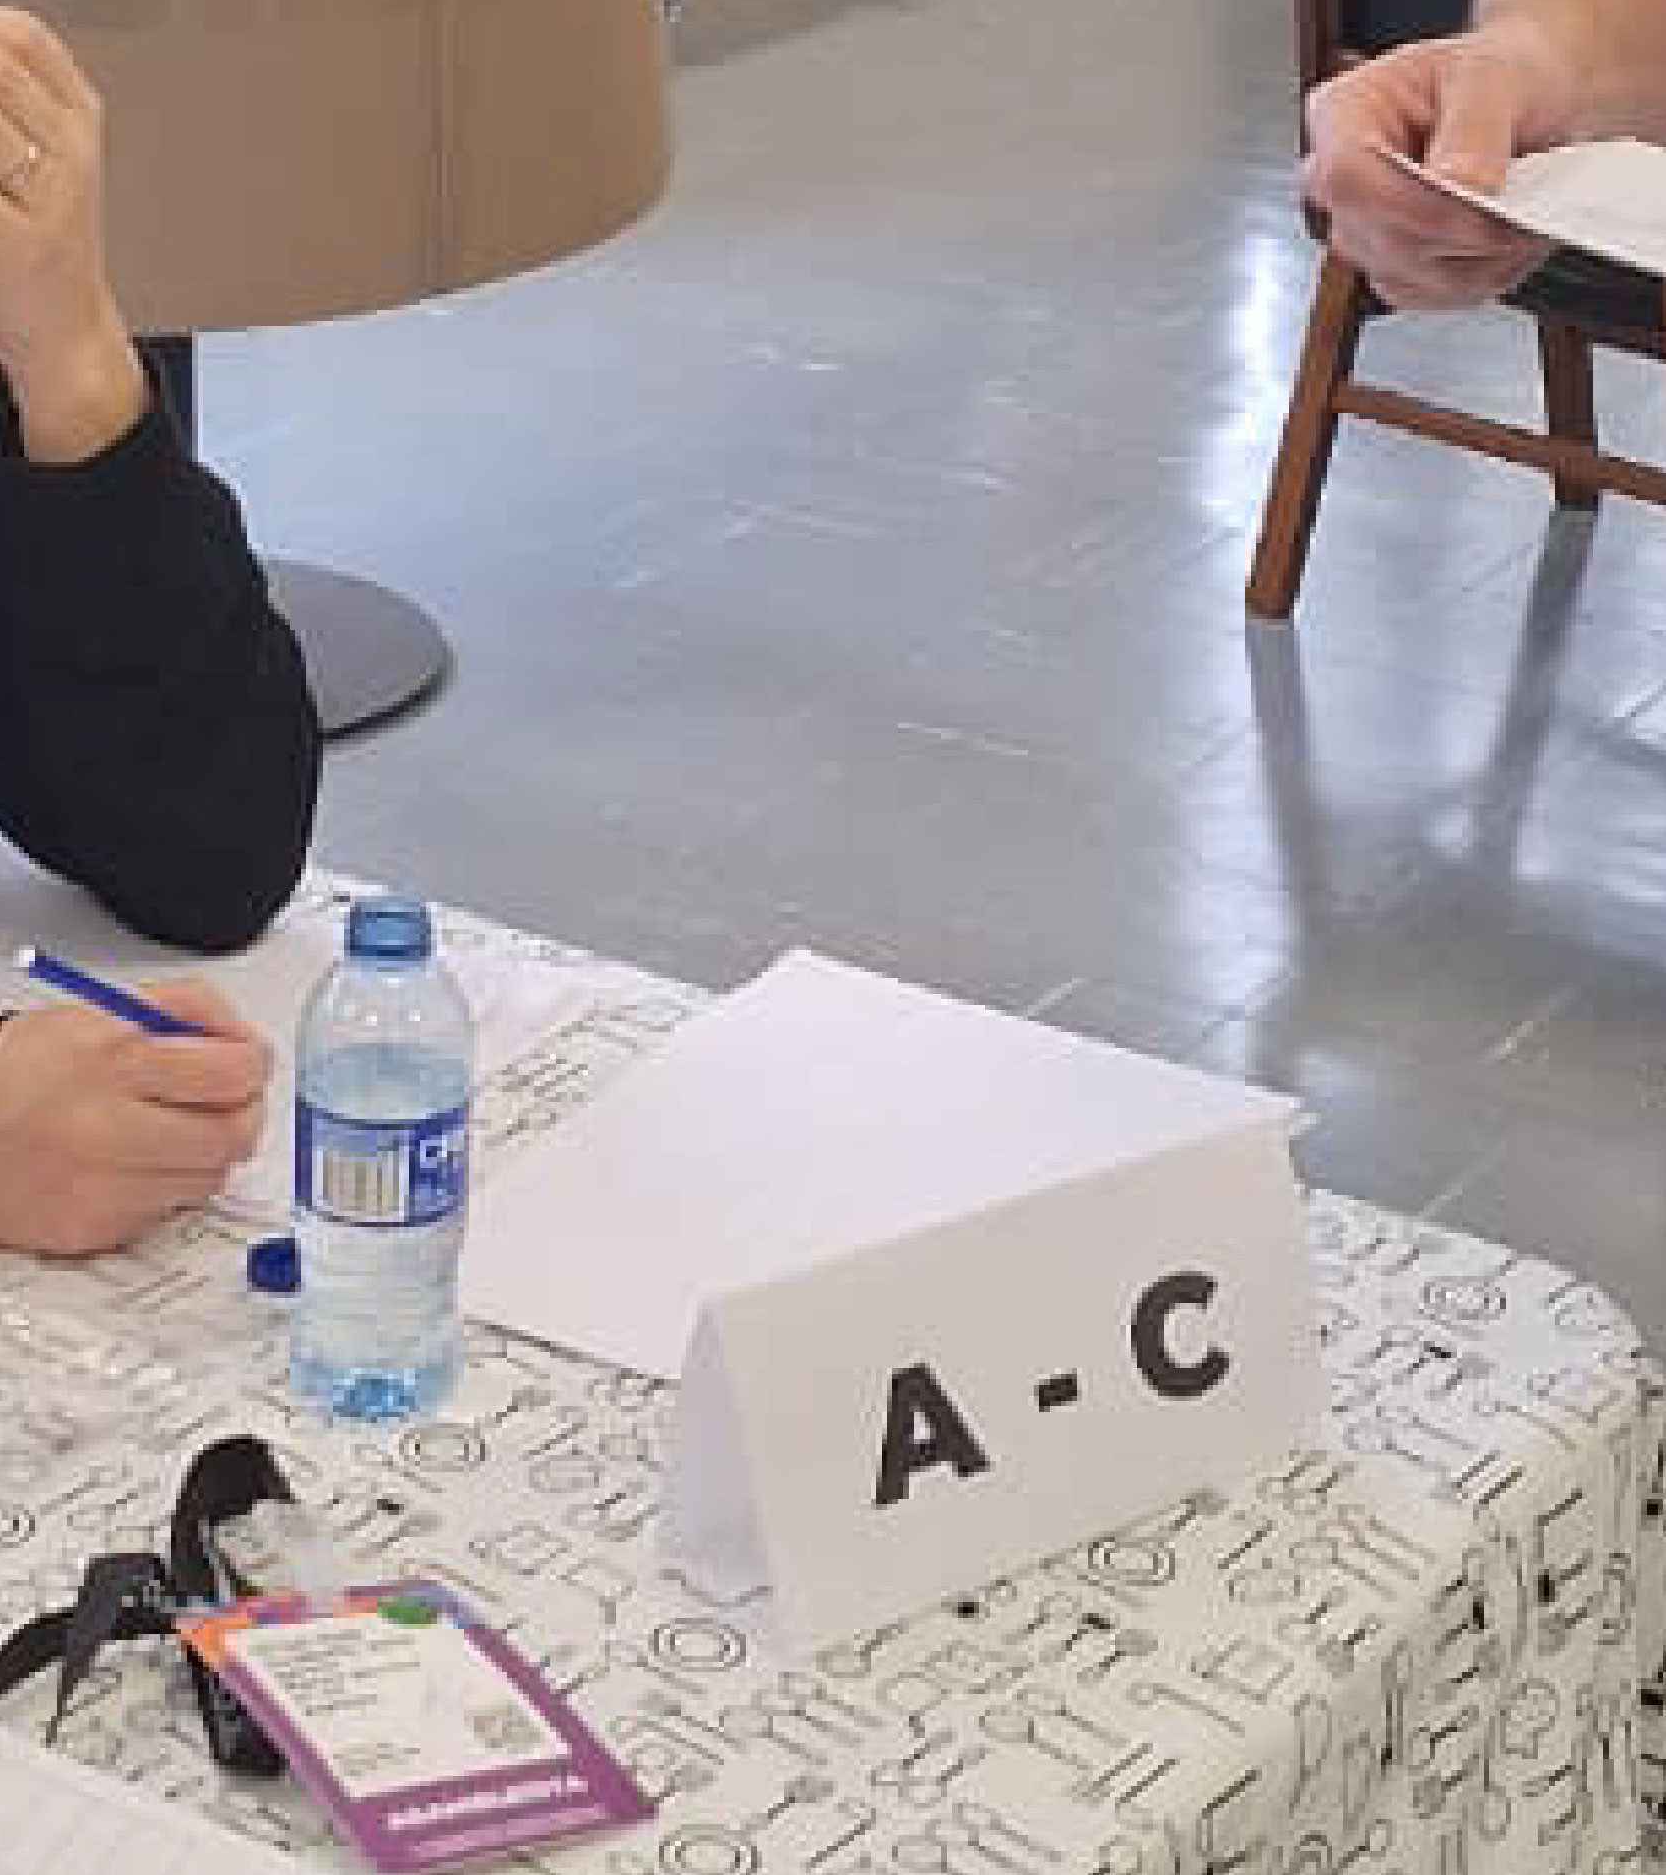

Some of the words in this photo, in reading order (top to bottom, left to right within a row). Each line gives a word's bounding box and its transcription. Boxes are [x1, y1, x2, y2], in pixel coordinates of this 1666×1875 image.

[871, 1362, 991, 1510] A
[1035, 1371, 1081, 1414] -
[1131, 1268, 1231, 1400] C
